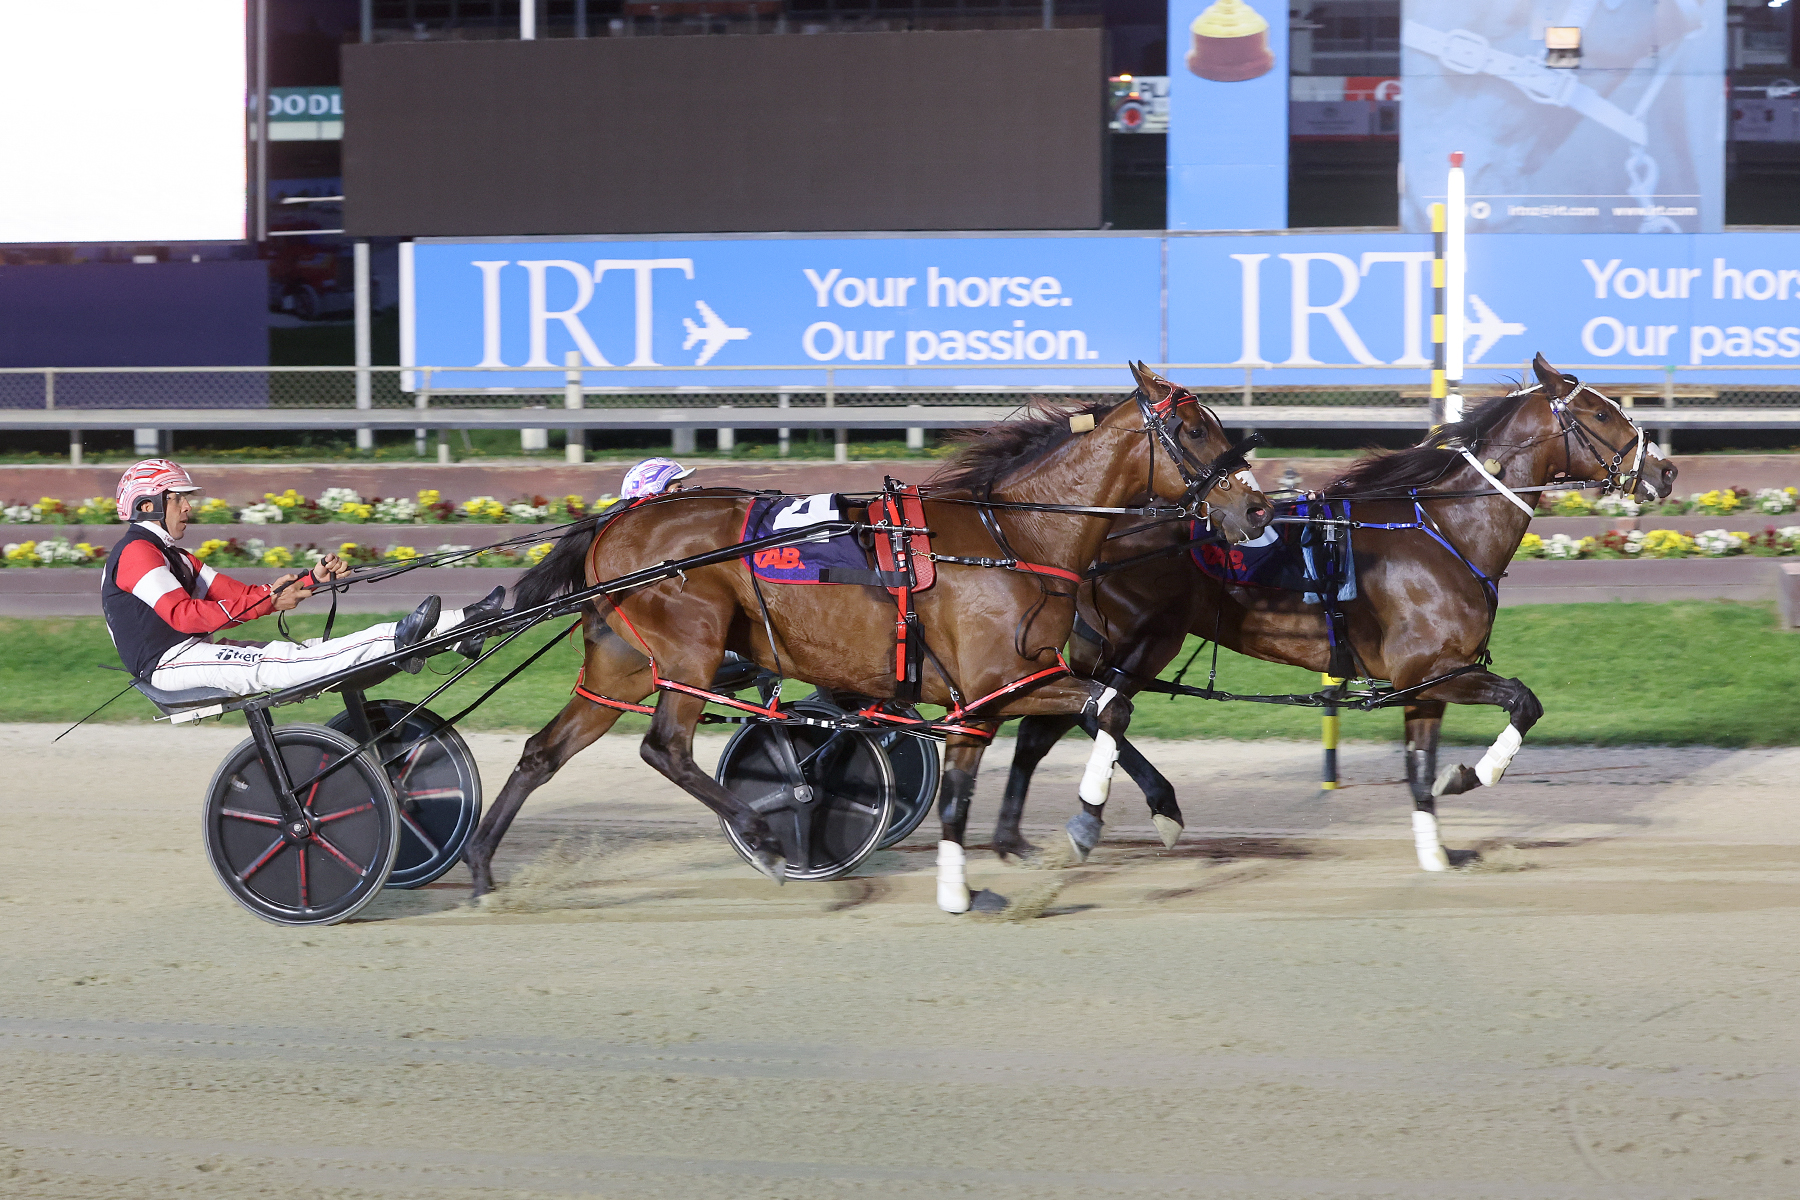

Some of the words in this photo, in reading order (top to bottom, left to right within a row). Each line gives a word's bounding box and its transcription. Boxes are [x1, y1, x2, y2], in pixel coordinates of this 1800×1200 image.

[802, 267, 917, 308] Your
[926, 266, 1073, 308] horse.
[1581, 258, 1702, 299] Your
[1711, 257, 1800, 301] hor
[470, 257, 695, 368] IRT
[1228, 251, 1467, 366] IRT
[802, 320, 895, 361] Our
[905, 319, 1099, 366] passion.
[1581, 316, 1678, 358] Our
